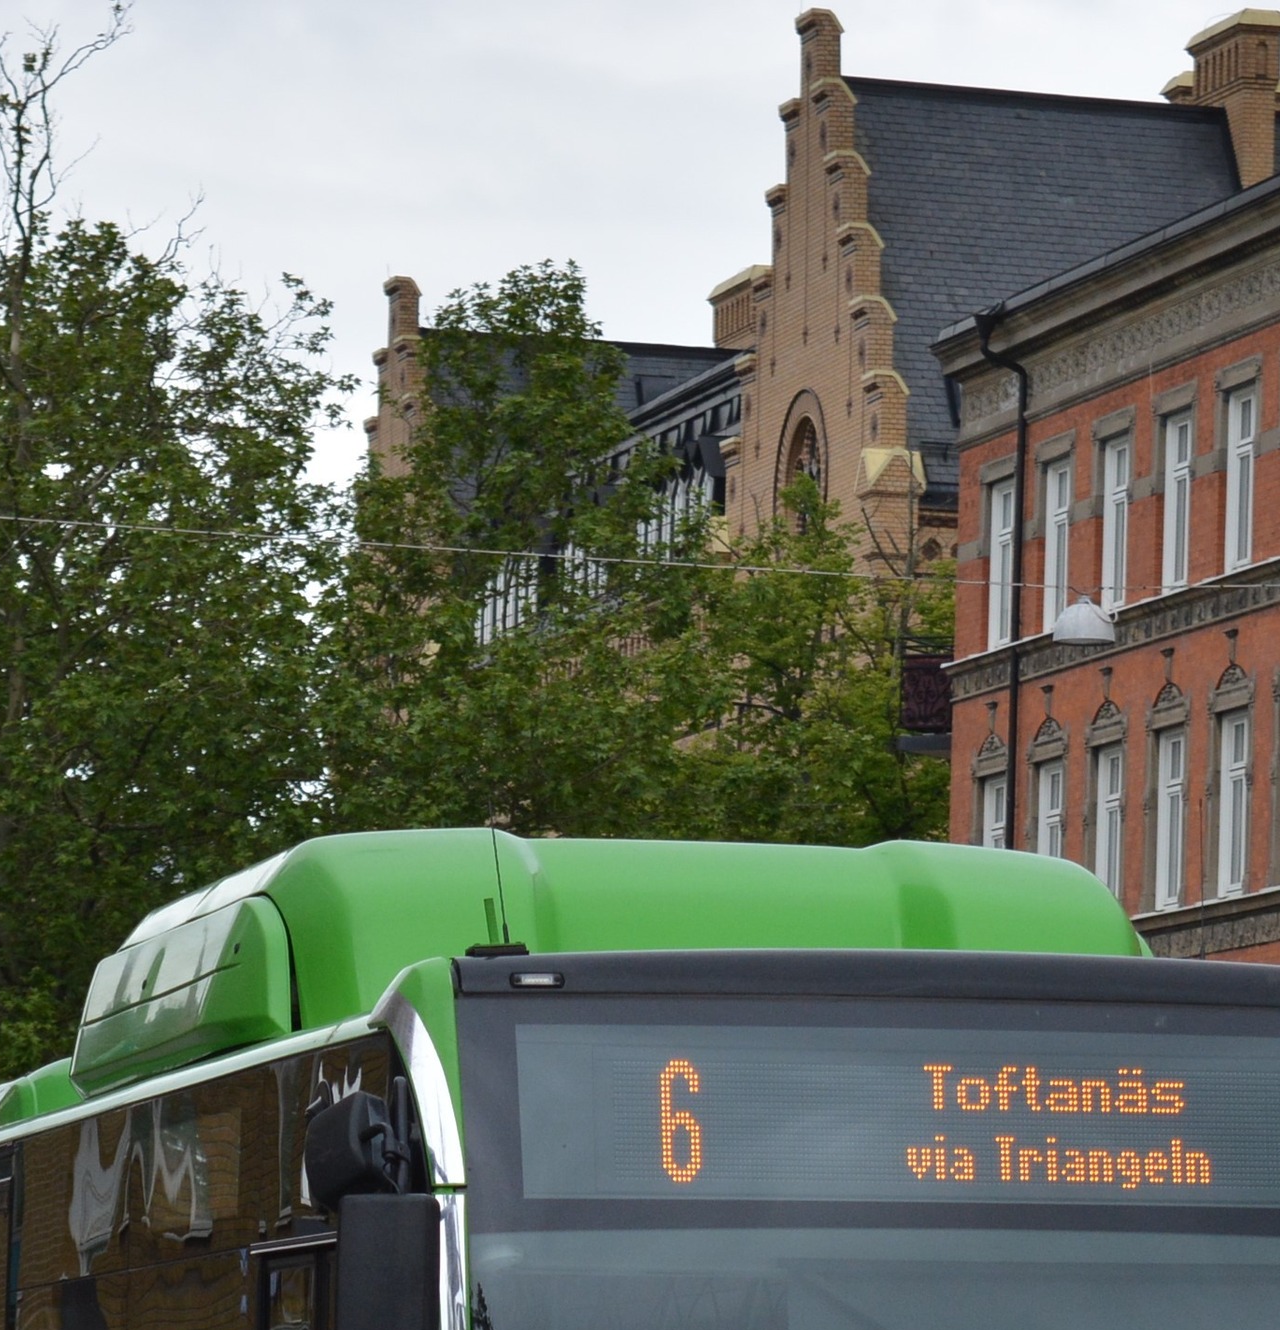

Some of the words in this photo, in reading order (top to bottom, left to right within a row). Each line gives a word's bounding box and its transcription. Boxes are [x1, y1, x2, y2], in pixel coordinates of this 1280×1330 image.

[923, 1064, 1184, 1114] Toftanäs
[658, 1058, 702, 1184] 6
[906, 1134, 975, 1181] via
[994, 1134, 1212, 1189] Triangeln
